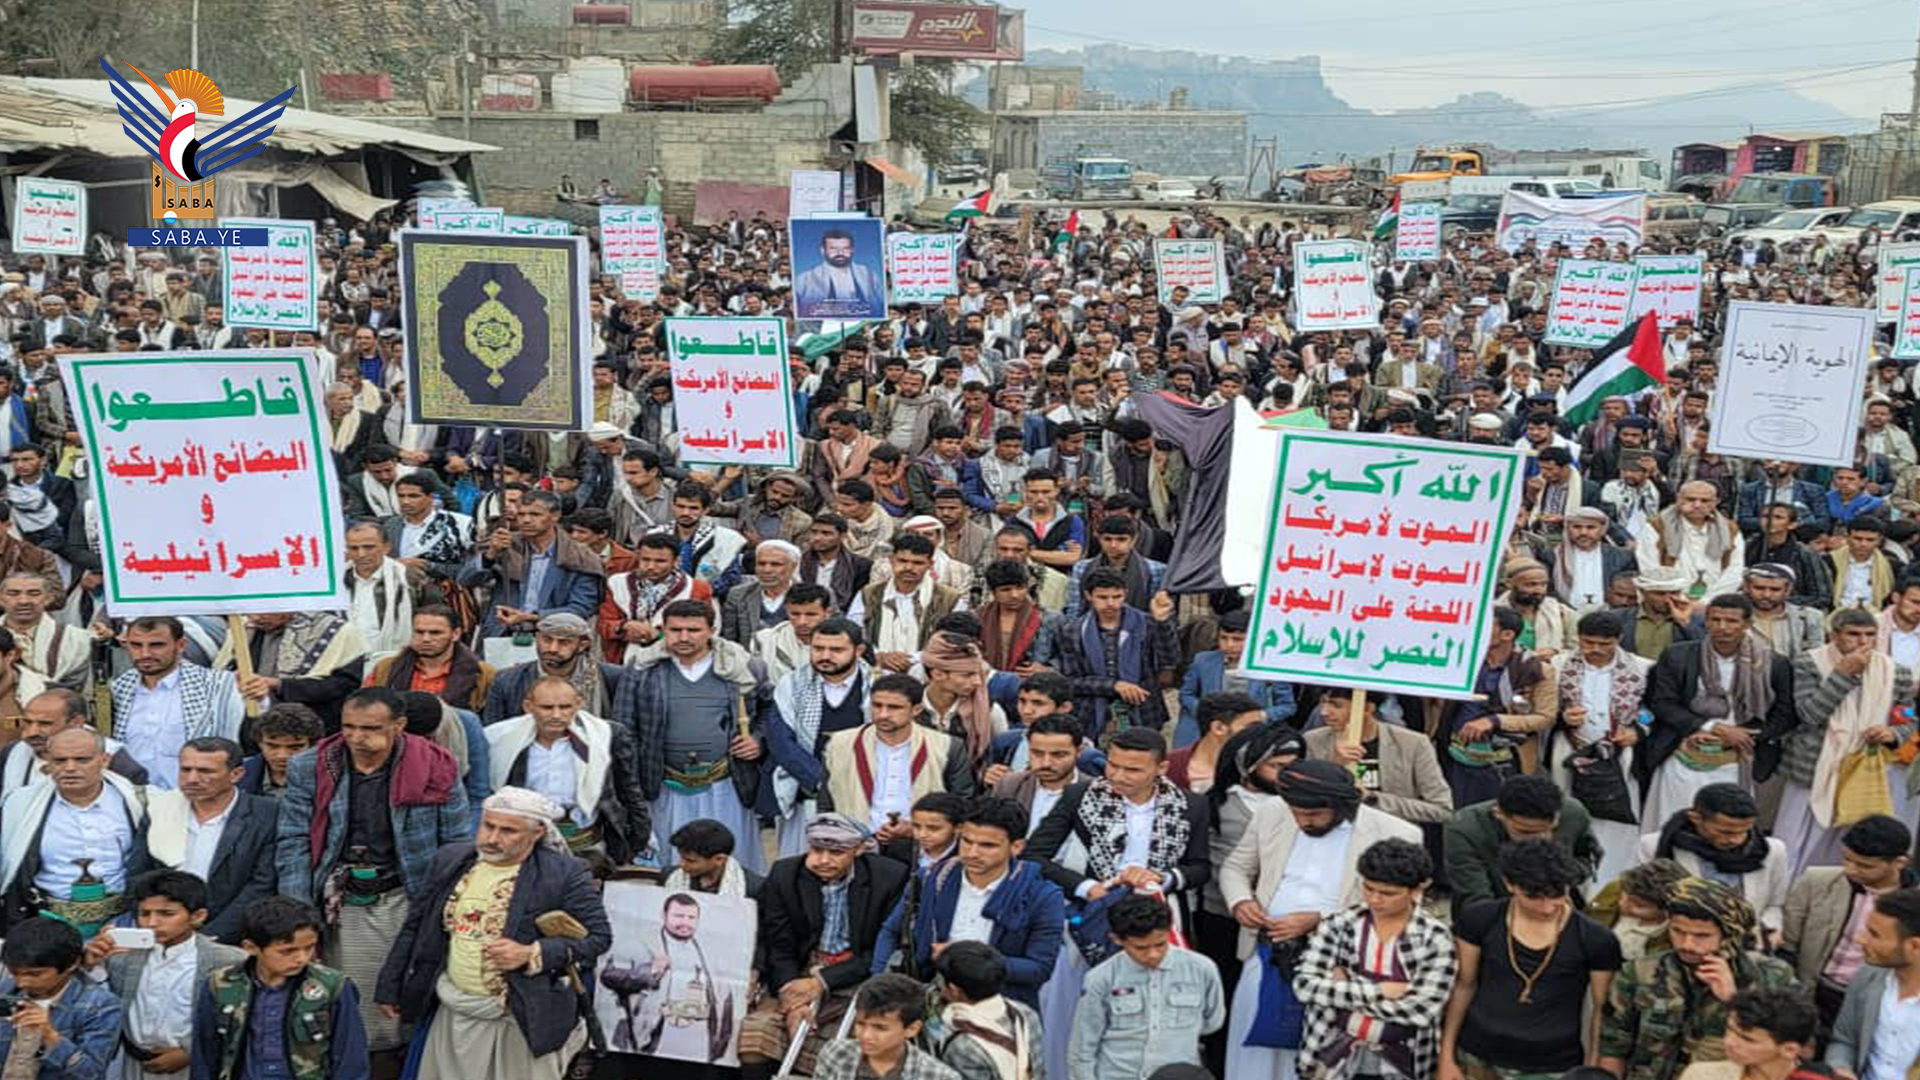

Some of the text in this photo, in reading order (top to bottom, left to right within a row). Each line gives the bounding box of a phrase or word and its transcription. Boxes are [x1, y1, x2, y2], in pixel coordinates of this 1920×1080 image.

[671, 329, 777, 360] قاطعوا
[91, 376, 300, 432] قاطعوا
[105, 438, 307, 485] البضائع الأمريكية
[1288, 453, 1500, 502] الله أكبر
[201, 493, 215, 524] و
[1399, 518, 1489, 546] الموت
[122, 533, 320, 581] الإسرائيلية
[1276, 543, 1480, 587] الموت لإسرائيل
[1269, 586, 1473, 626] اللعنة على اليهود
[1261, 620, 1465, 670] النصر للإسلام
